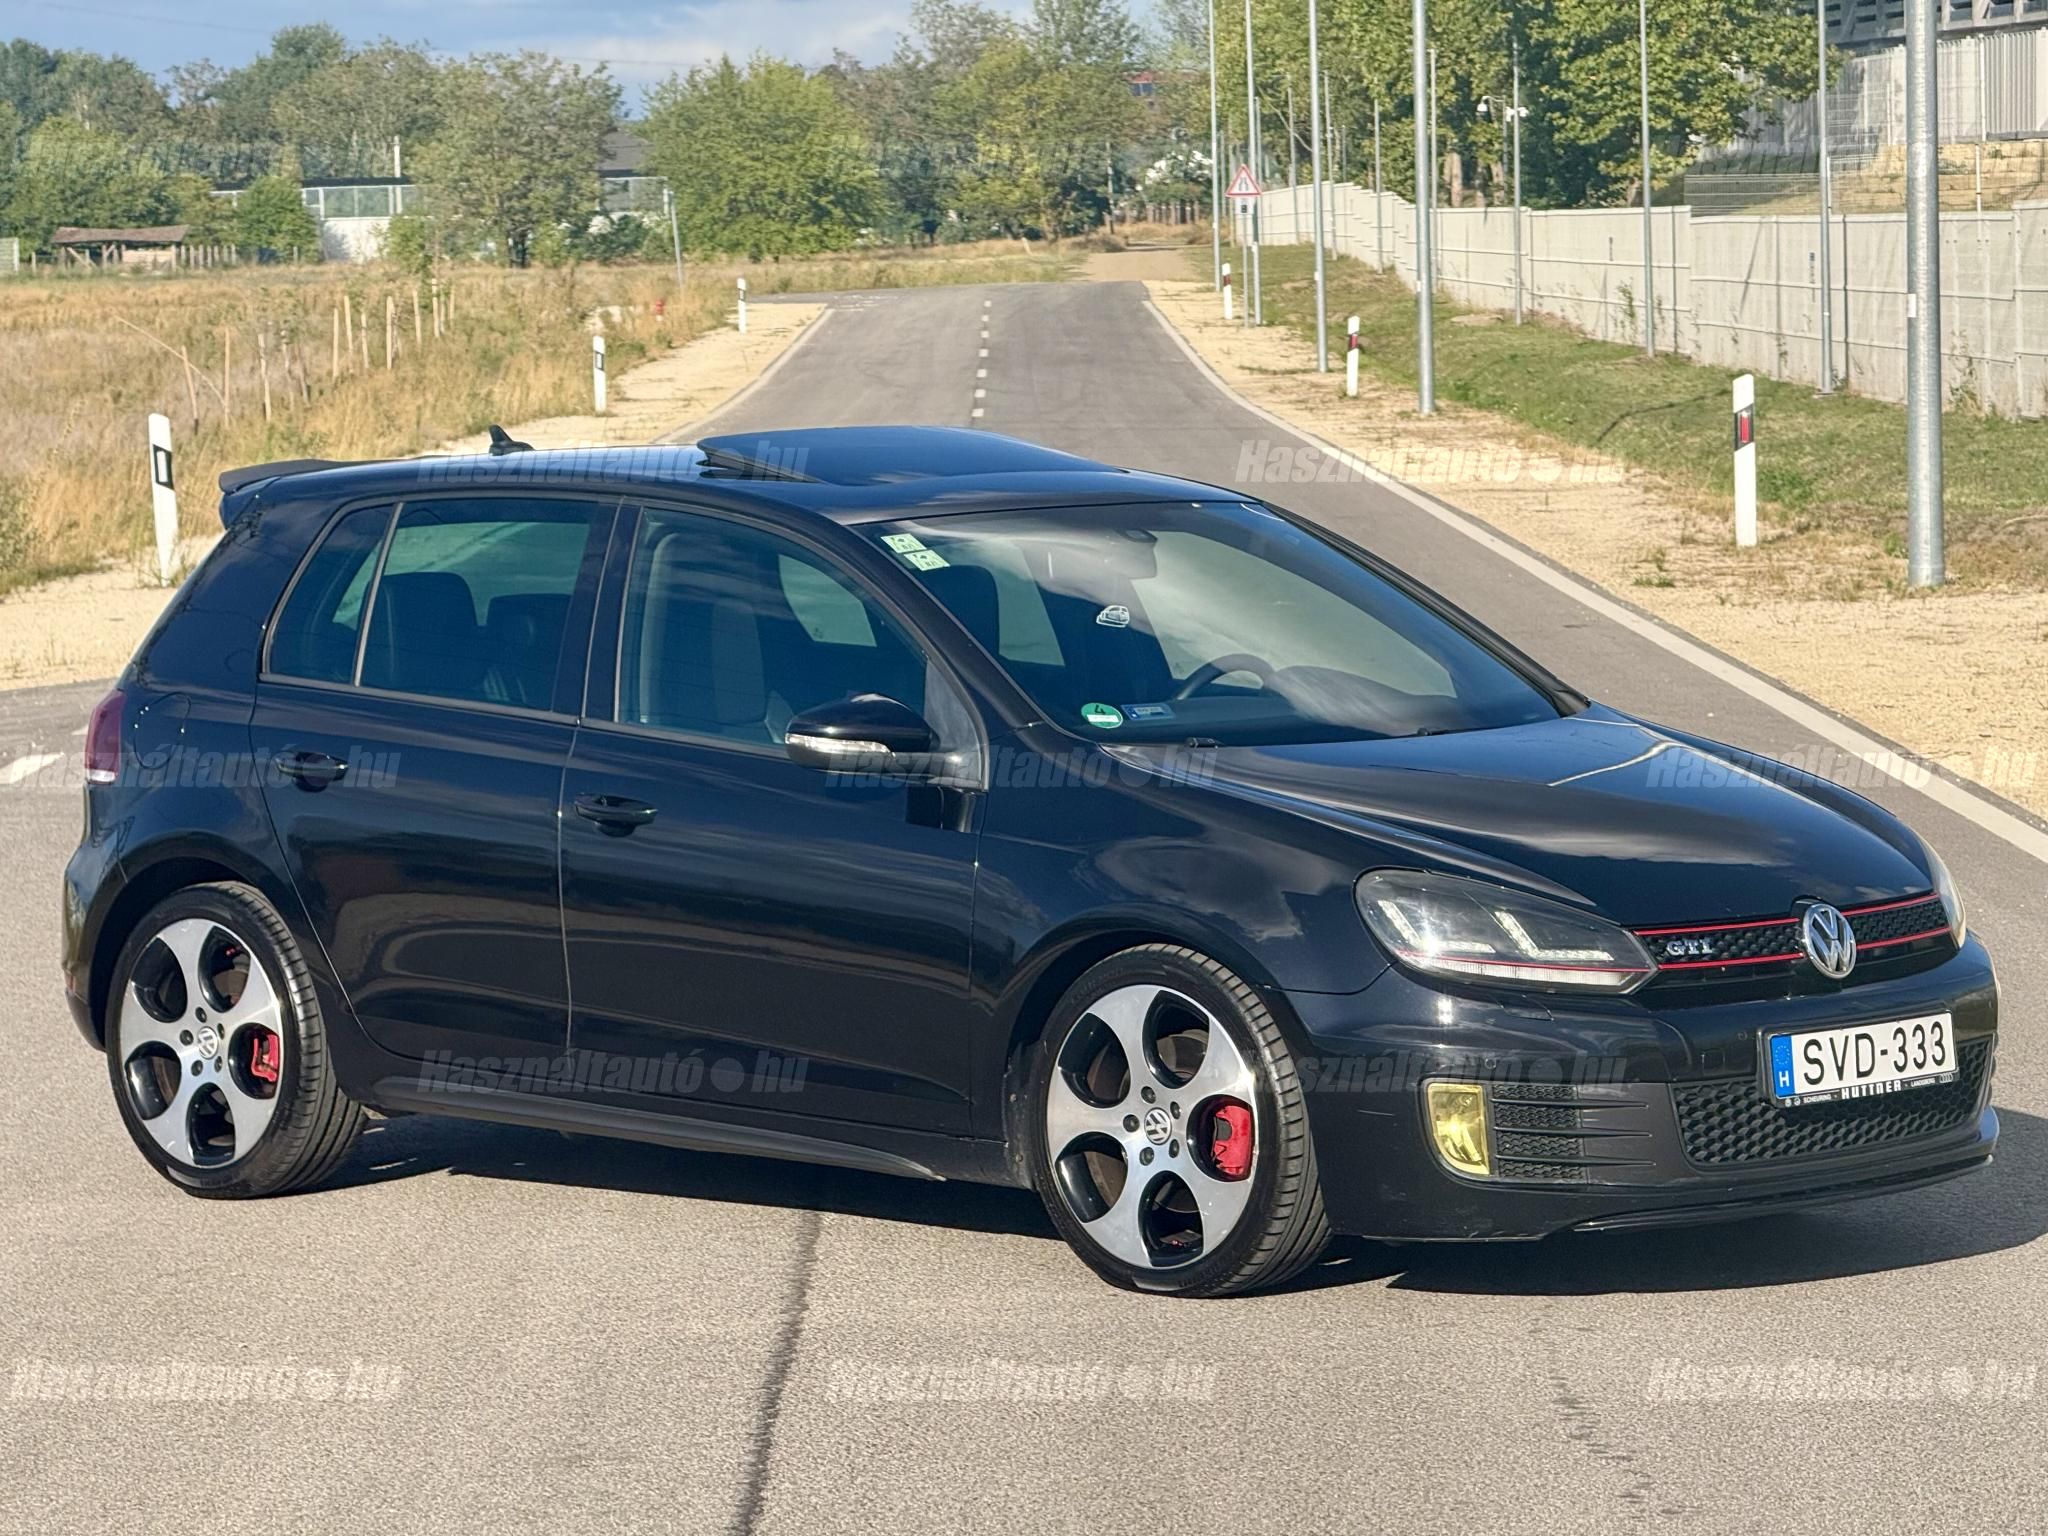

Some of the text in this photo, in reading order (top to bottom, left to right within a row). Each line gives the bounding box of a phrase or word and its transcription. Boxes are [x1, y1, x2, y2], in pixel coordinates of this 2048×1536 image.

[1666, 937, 1713, 957] GTI
[1803, 1021, 1946, 1086] SVD-333
[1778, 1071, 1790, 1088] H
